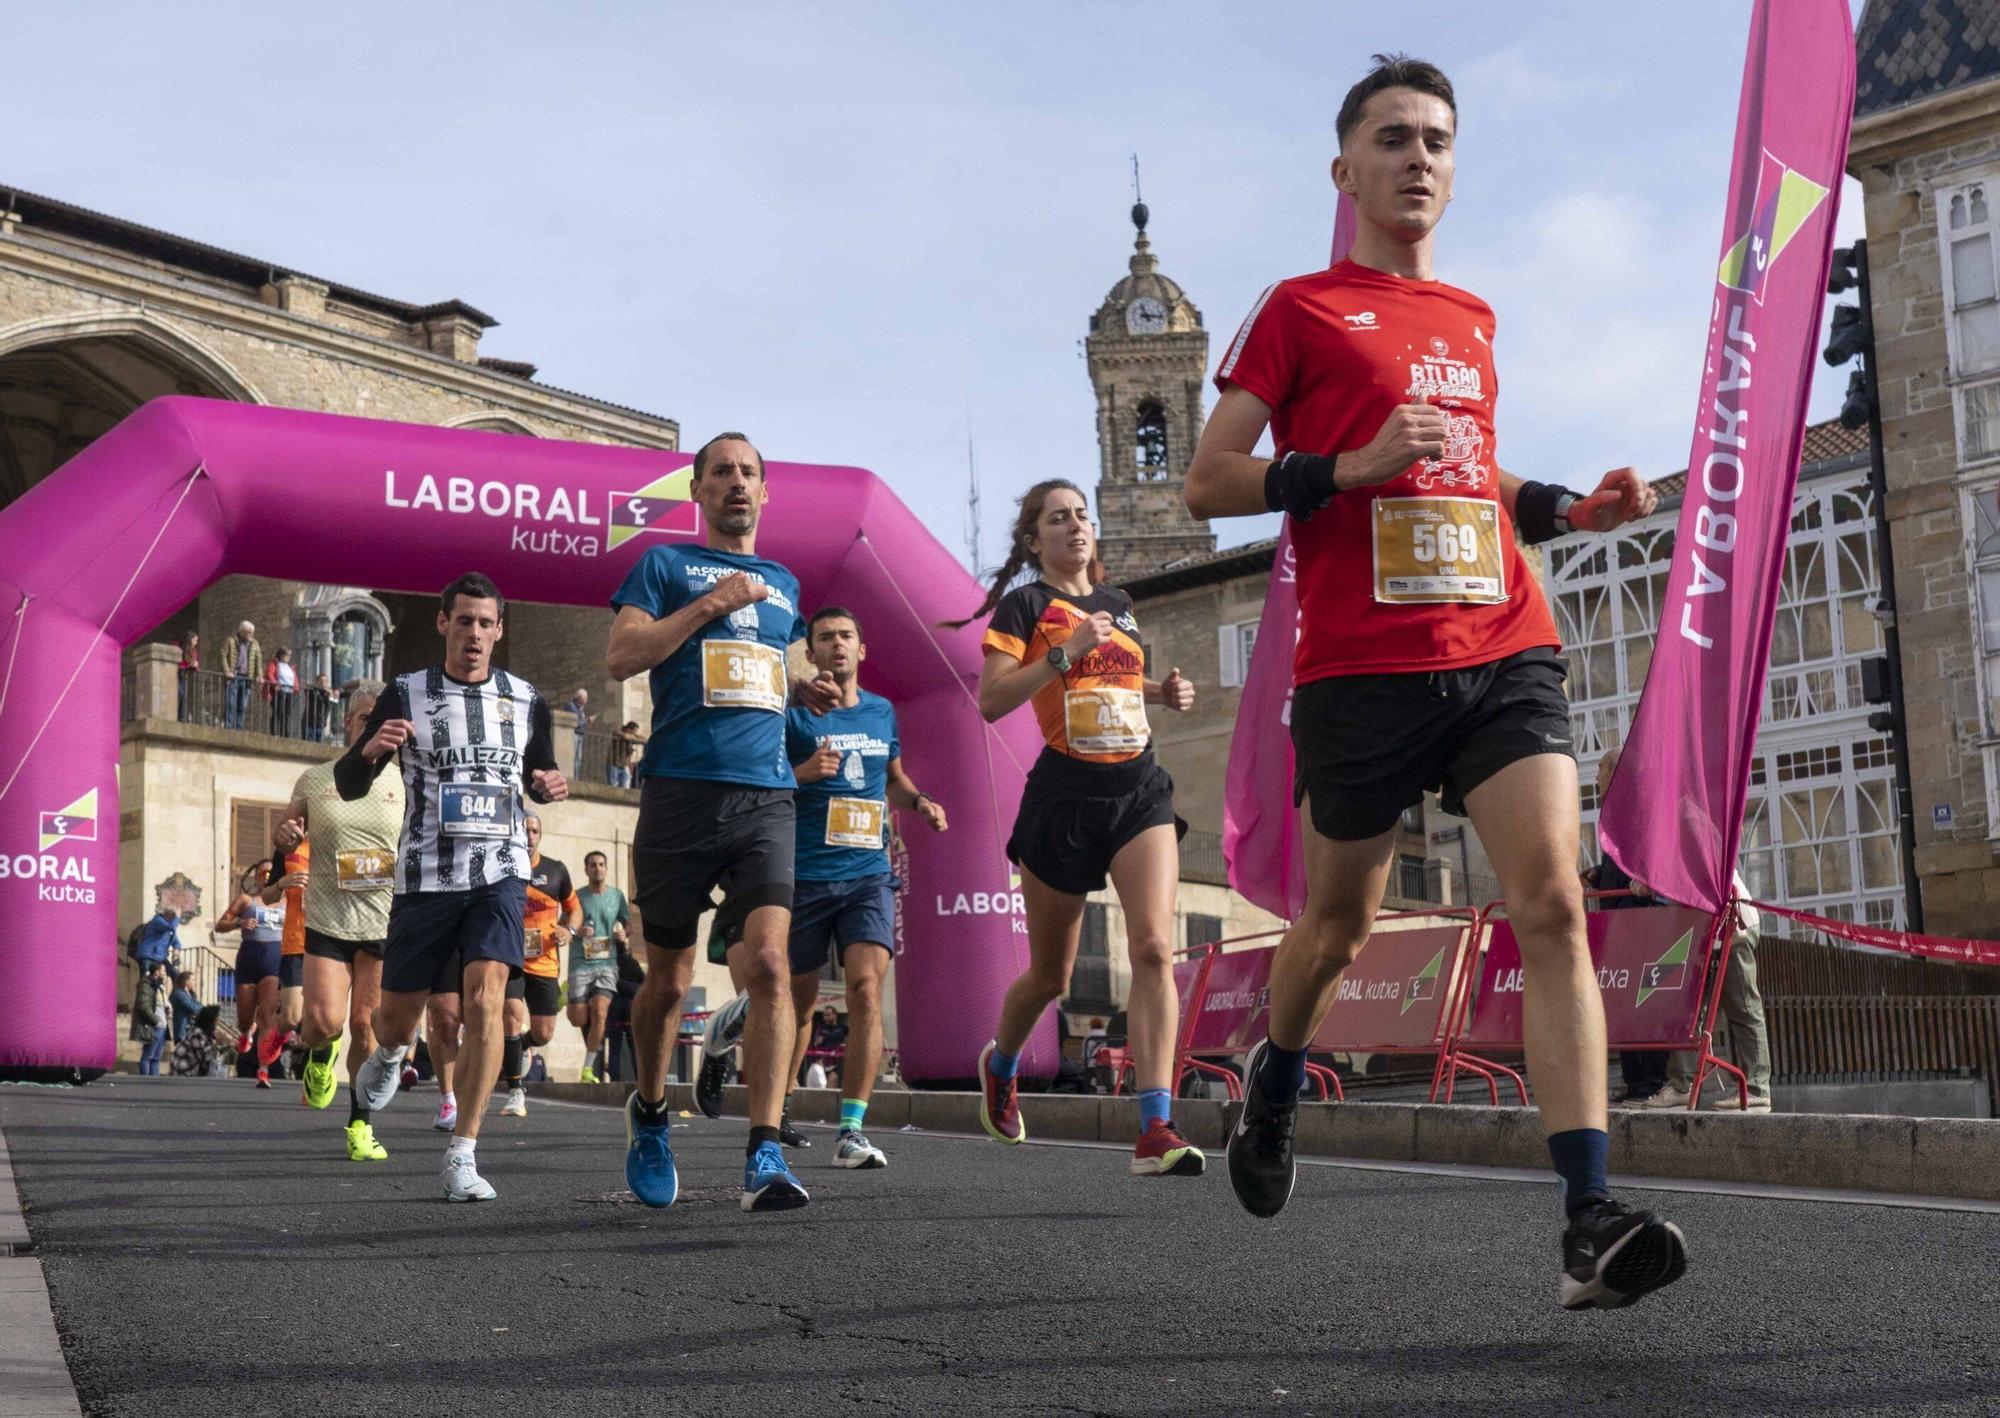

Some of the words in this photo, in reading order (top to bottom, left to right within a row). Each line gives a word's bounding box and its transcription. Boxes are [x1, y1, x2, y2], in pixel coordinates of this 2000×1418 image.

[1410, 363, 1481, 391] BILBAO
[385, 470, 600, 525] LABORAL
[511, 525, 599, 557] kutxa
[1413, 523, 1478, 563] 569
[460, 795, 496, 817] 844
[848, 811, 872, 830] 119
[355, 857, 381, 874] 212
[39, 883, 95, 904] kutxa
[1365, 979, 1400, 999] kutxa
